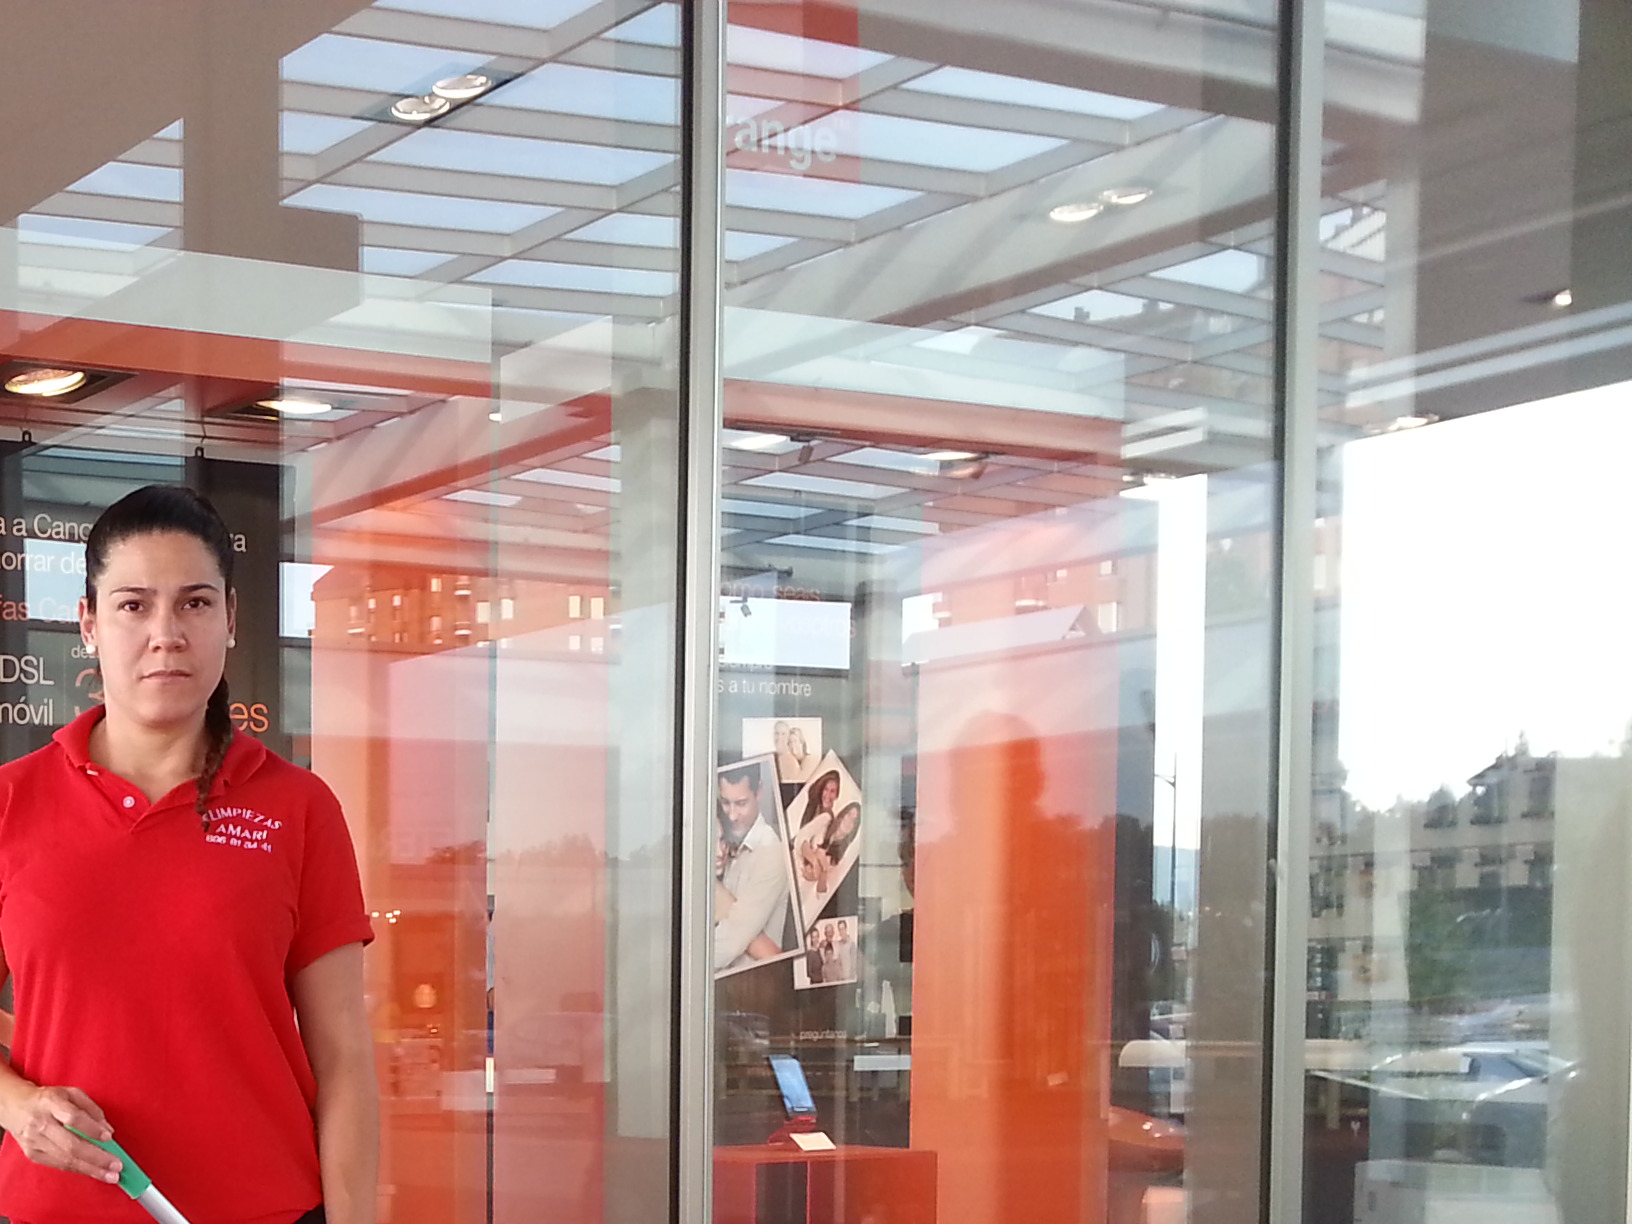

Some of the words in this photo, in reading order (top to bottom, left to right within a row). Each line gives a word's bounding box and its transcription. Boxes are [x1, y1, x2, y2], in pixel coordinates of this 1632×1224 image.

[12, 517, 27, 536] a
[728, 681, 738, 694] a
[743, 679, 755, 695] tu
[759, 679, 812, 697] nombre
[208, 807, 283, 830] LIMPIEZAS
